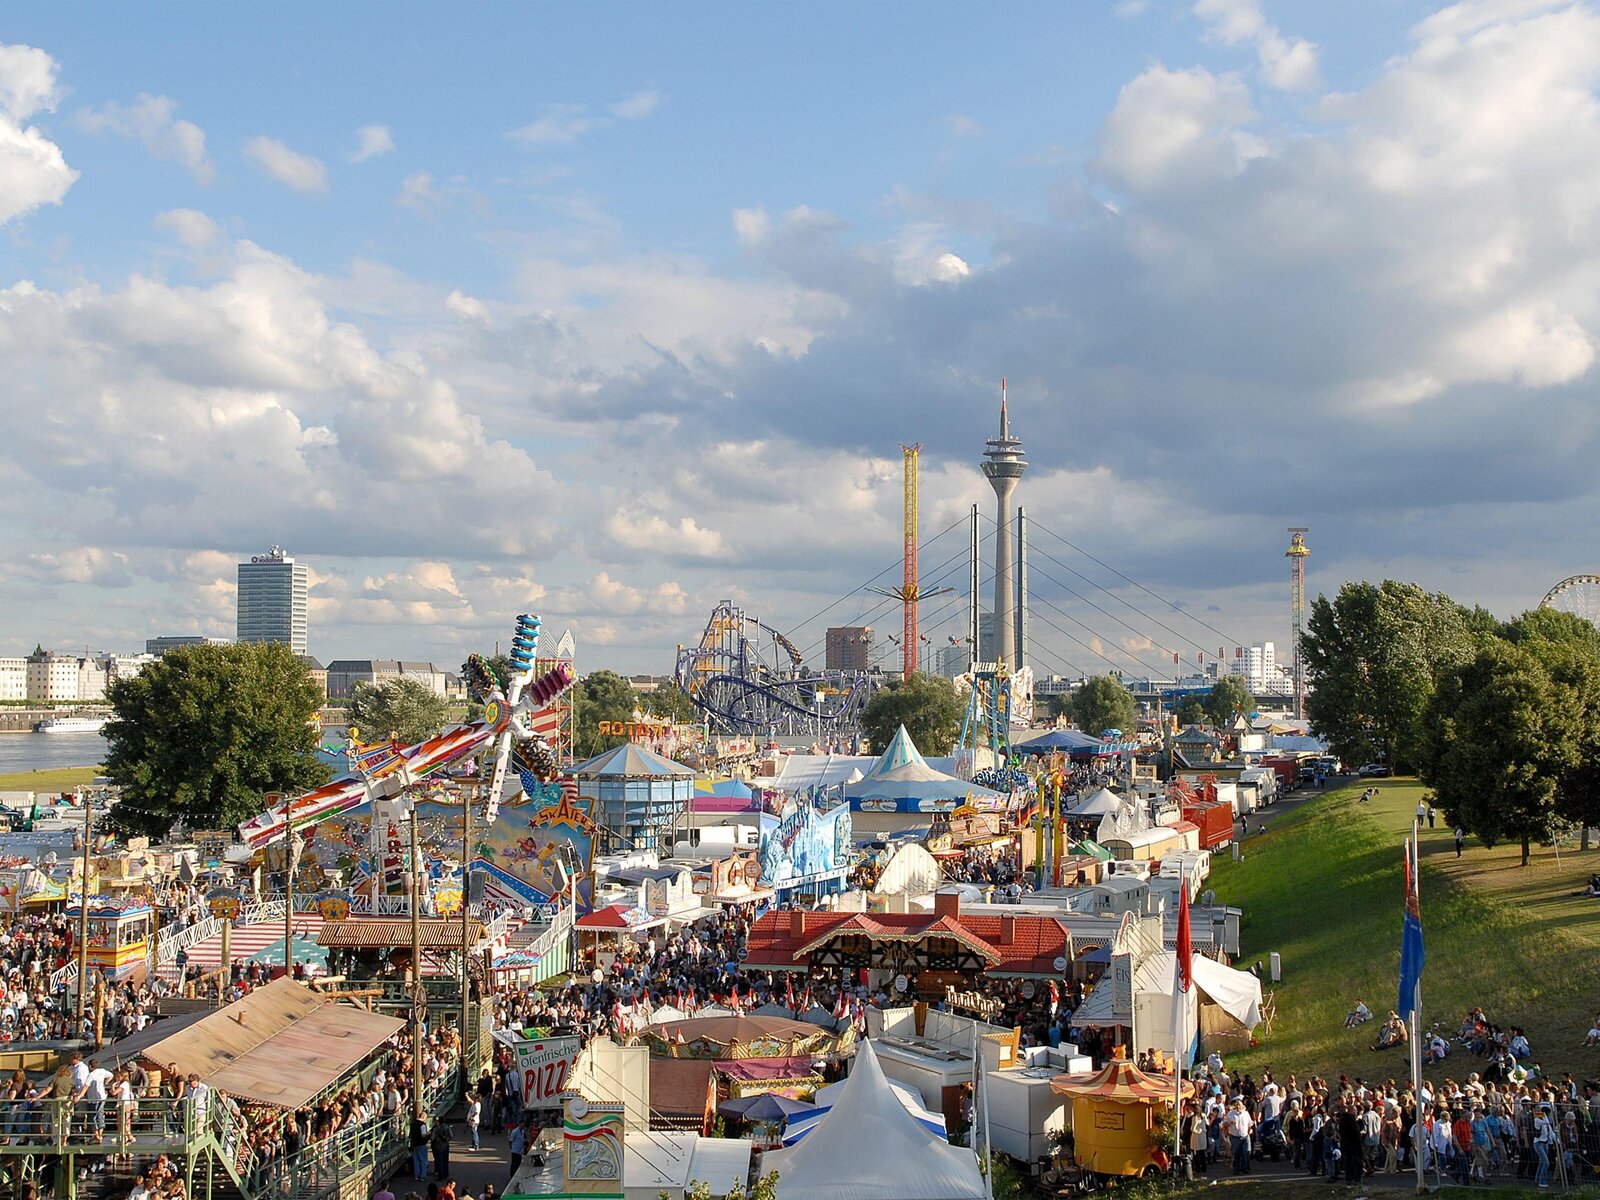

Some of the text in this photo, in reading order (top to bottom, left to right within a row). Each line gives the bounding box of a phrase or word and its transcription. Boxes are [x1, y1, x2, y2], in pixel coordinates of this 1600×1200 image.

[1116, 967, 1130, 983] EIS
[521, 1043, 577, 1069] Ofenfrische
[524, 1055, 577, 1104] PIZZ
